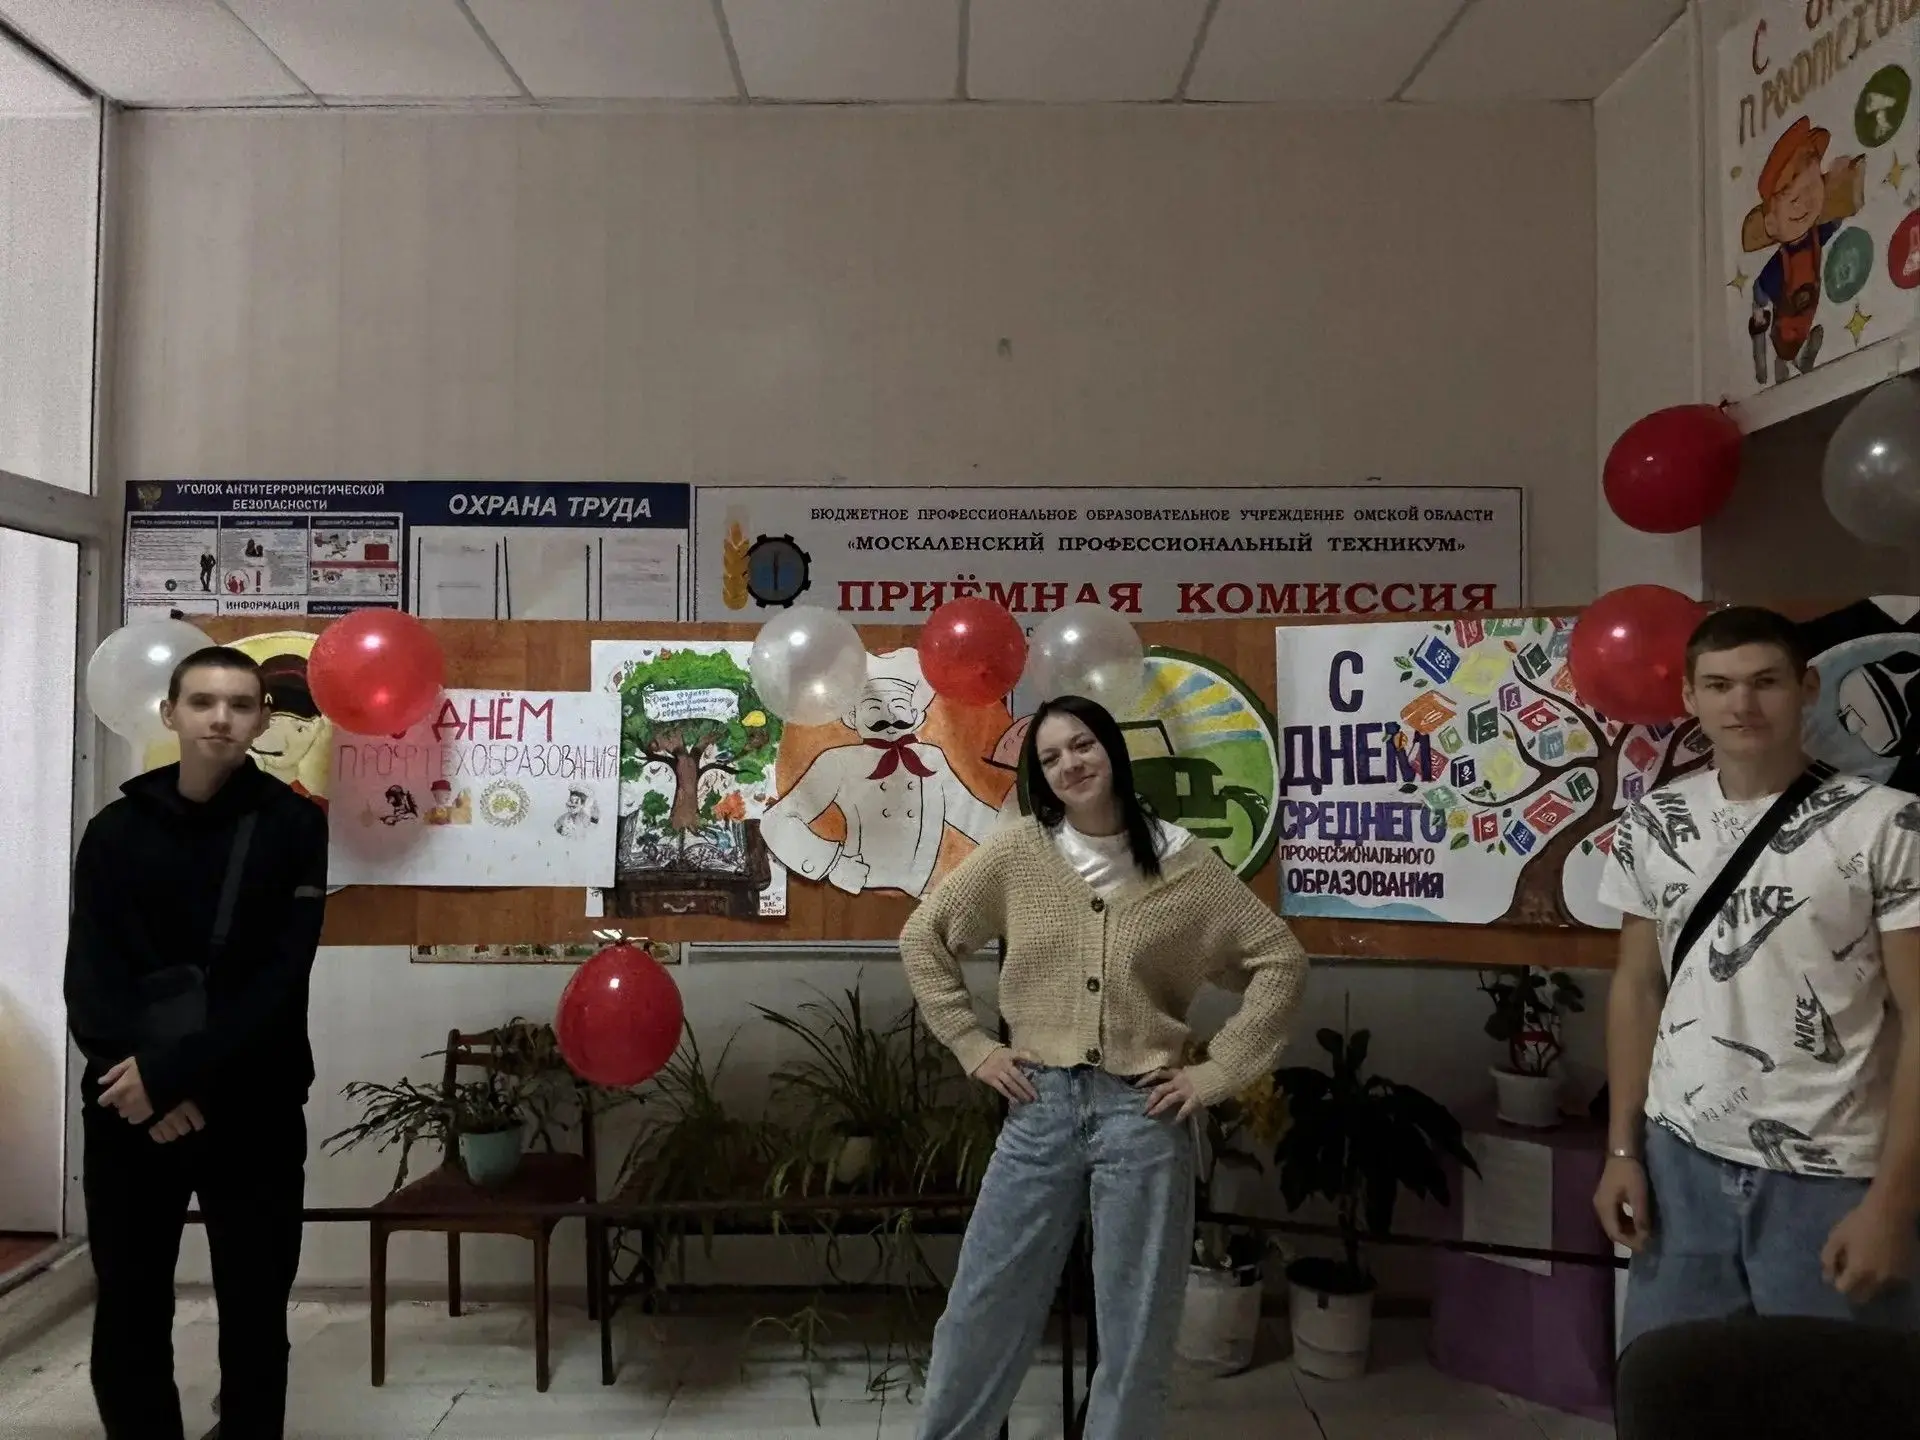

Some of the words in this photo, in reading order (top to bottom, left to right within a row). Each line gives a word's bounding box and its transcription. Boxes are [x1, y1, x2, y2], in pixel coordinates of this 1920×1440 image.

[176, 484, 223, 496] УГОЛОК
[225, 483, 385, 496] АНТИТЕРРОРИСТИЧЕСКОЙ
[232, 499, 328, 511] БЕЗОПАСНОСТИ
[449, 493, 557, 516] ОХРАНА
[568, 496, 651, 522] ТРУДА
[810, 508, 909, 522] БЮДЖЕТНОЕ
[917, 508, 1077, 521] ПРОФЕССИОНАЛЬНОЕ
[1086, 508, 1230, 521] ОБРАЗОВАТЕЛЬНОЕ
[1240, 508, 1345, 523] УЧРЕЖДЕНИЕ
[1353, 505, 1419, 521] ОМСКОЙ
[1423, 508, 1494, 522] ОБЛАСТИ
[847, 532, 1045, 552] «МОСКАЛЕНСКИЙ
[1058, 532, 1313, 552] ПРОФЕССИОНАЛЬНЫЙ
[1327, 535, 1466, 553] ТЕХНИКУМ»
[225, 600, 300, 612] ИНФОРМАЦИЯ
[1176, 581, 1498, 615] КОМИССИЯ
[1329, 650, 1364, 713] С
[431, 691, 554, 743] ДНЁМ
[1279, 721, 1434, 797] ДНЕМ
[1277, 800, 1448, 847] СРЕДНЕГО
[1281, 844, 1436, 866] ПРОФЕССИОНАЛЬНОГО
[1287, 867, 1444, 899] ОБРАЗОВАНИЯ
